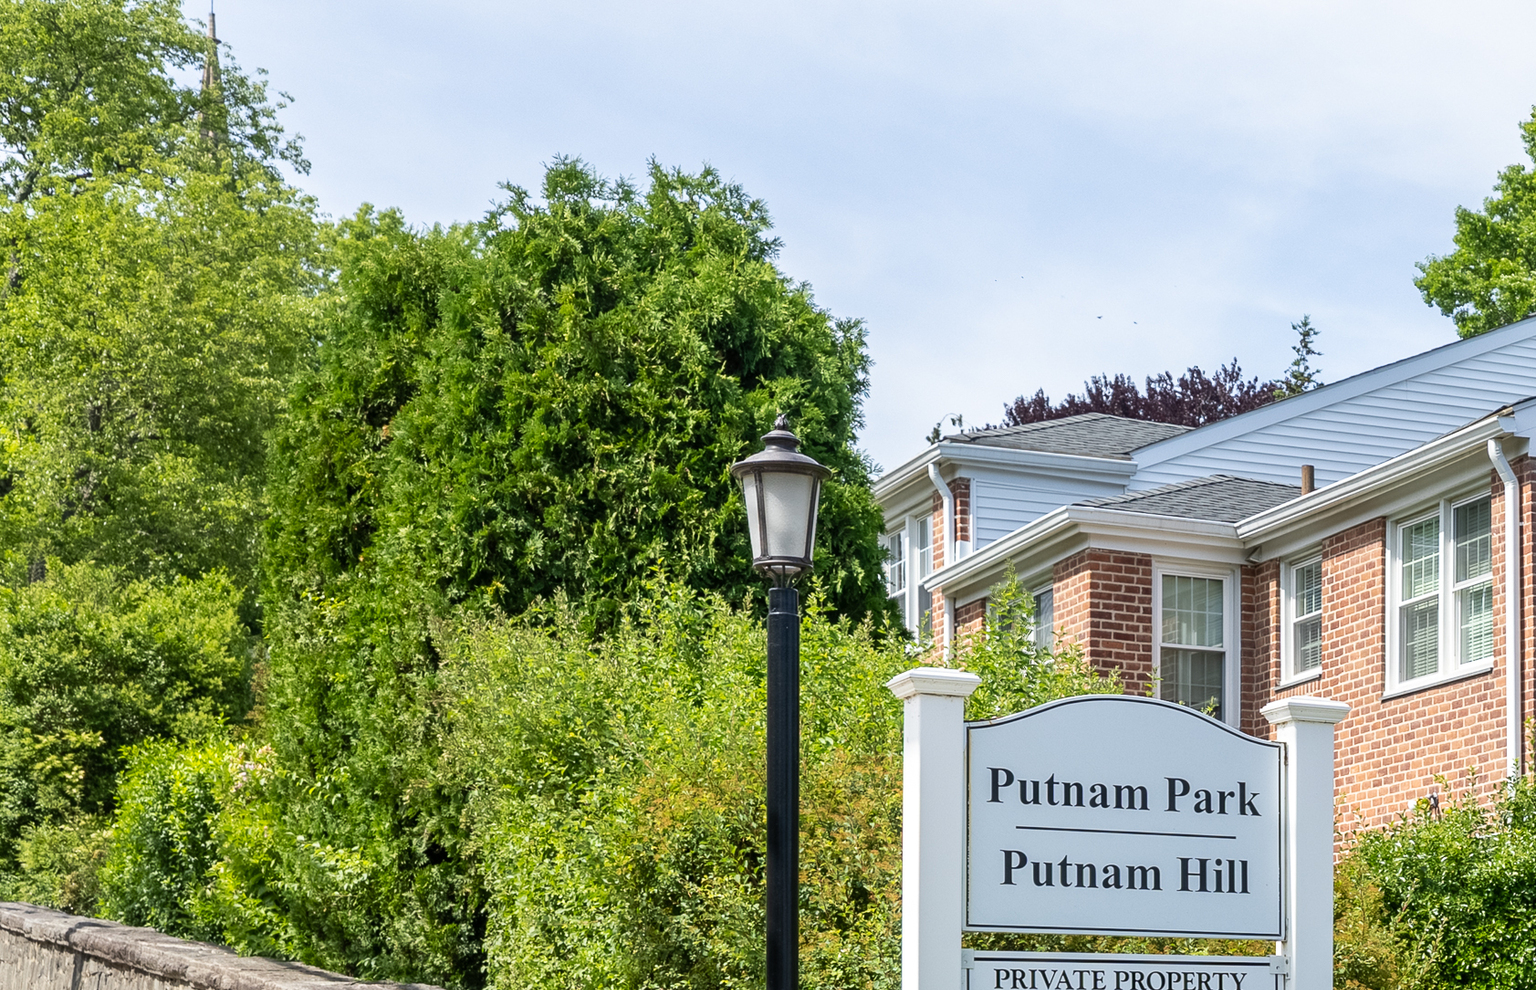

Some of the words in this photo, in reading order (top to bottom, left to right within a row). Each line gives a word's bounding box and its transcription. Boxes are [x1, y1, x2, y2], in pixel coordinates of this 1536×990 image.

[986, 766, 1150, 811] Putnam
[1164, 777, 1262, 817] Park
[999, 849, 1162, 891] Putnam
[1177, 856, 1251, 894] Hill
[994, 968, 1107, 990] PRIVATE
